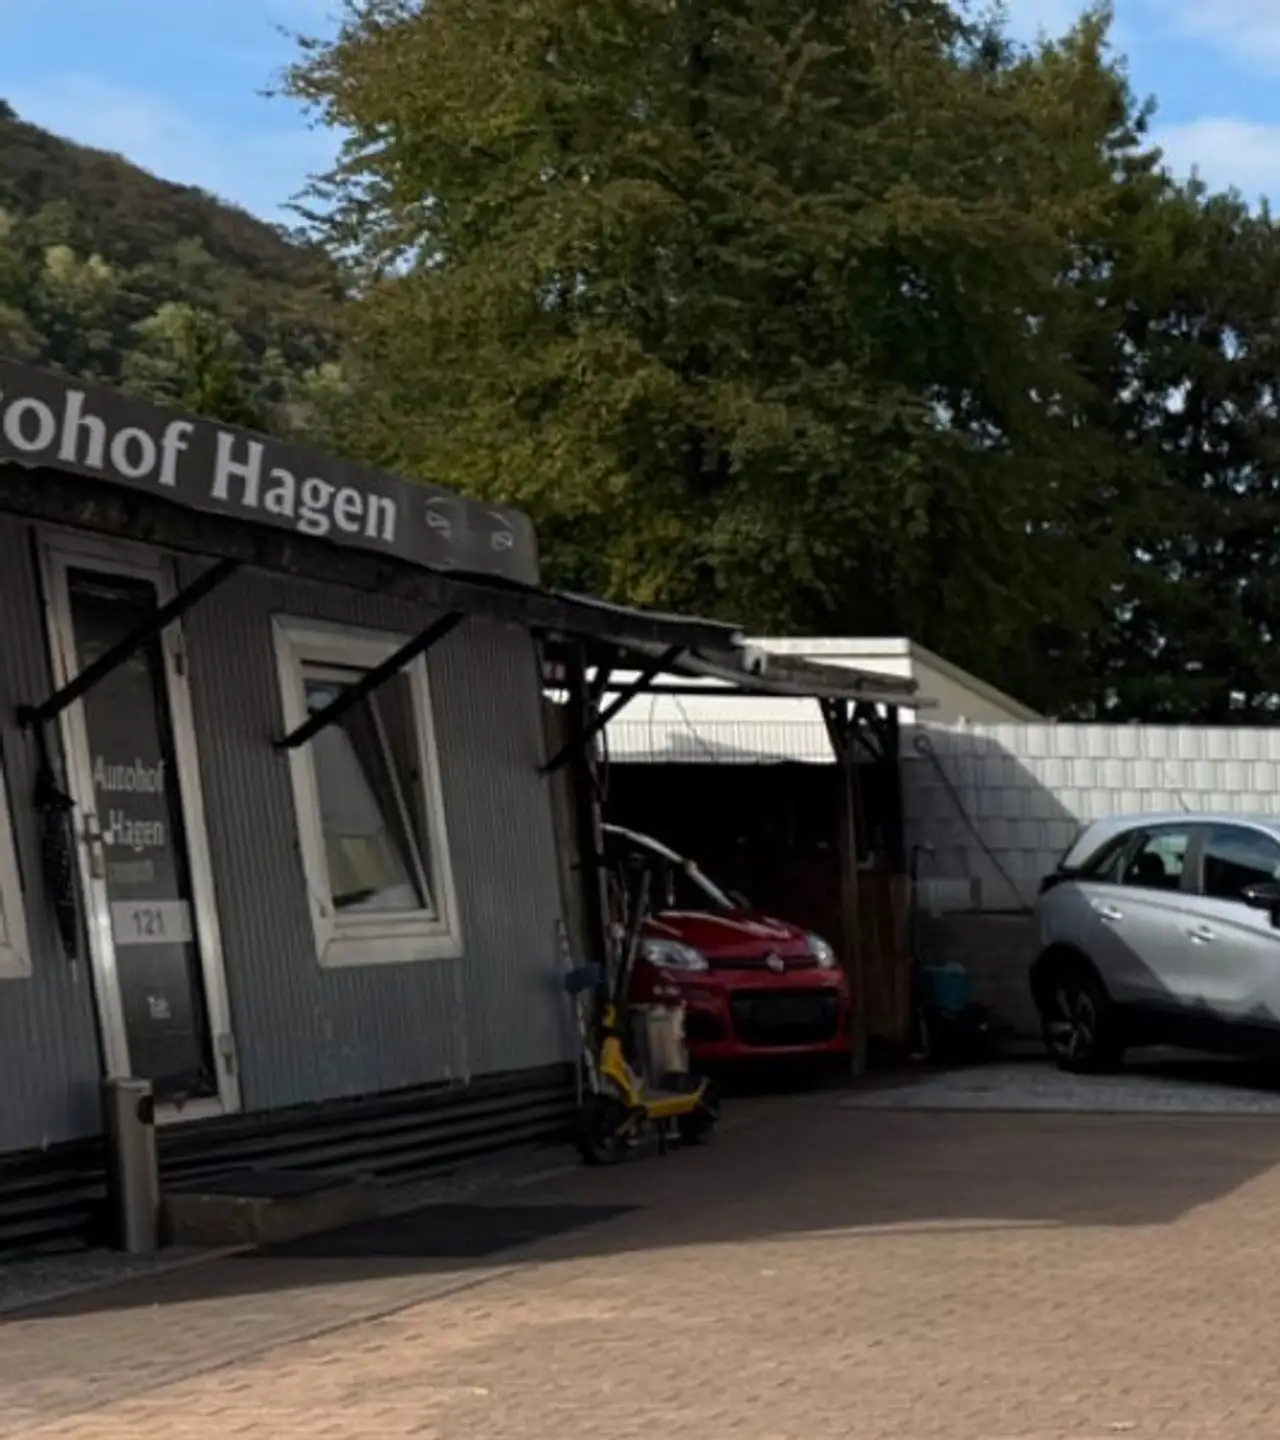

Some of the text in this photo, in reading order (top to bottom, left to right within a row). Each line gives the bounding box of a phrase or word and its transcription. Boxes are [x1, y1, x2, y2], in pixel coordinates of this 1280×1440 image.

[0, 388, 397, 543] ohof Hagen
[93, 755, 165, 793] Autohof
[109, 810, 164, 851] Hagen
[131, 906, 165, 937] 121
